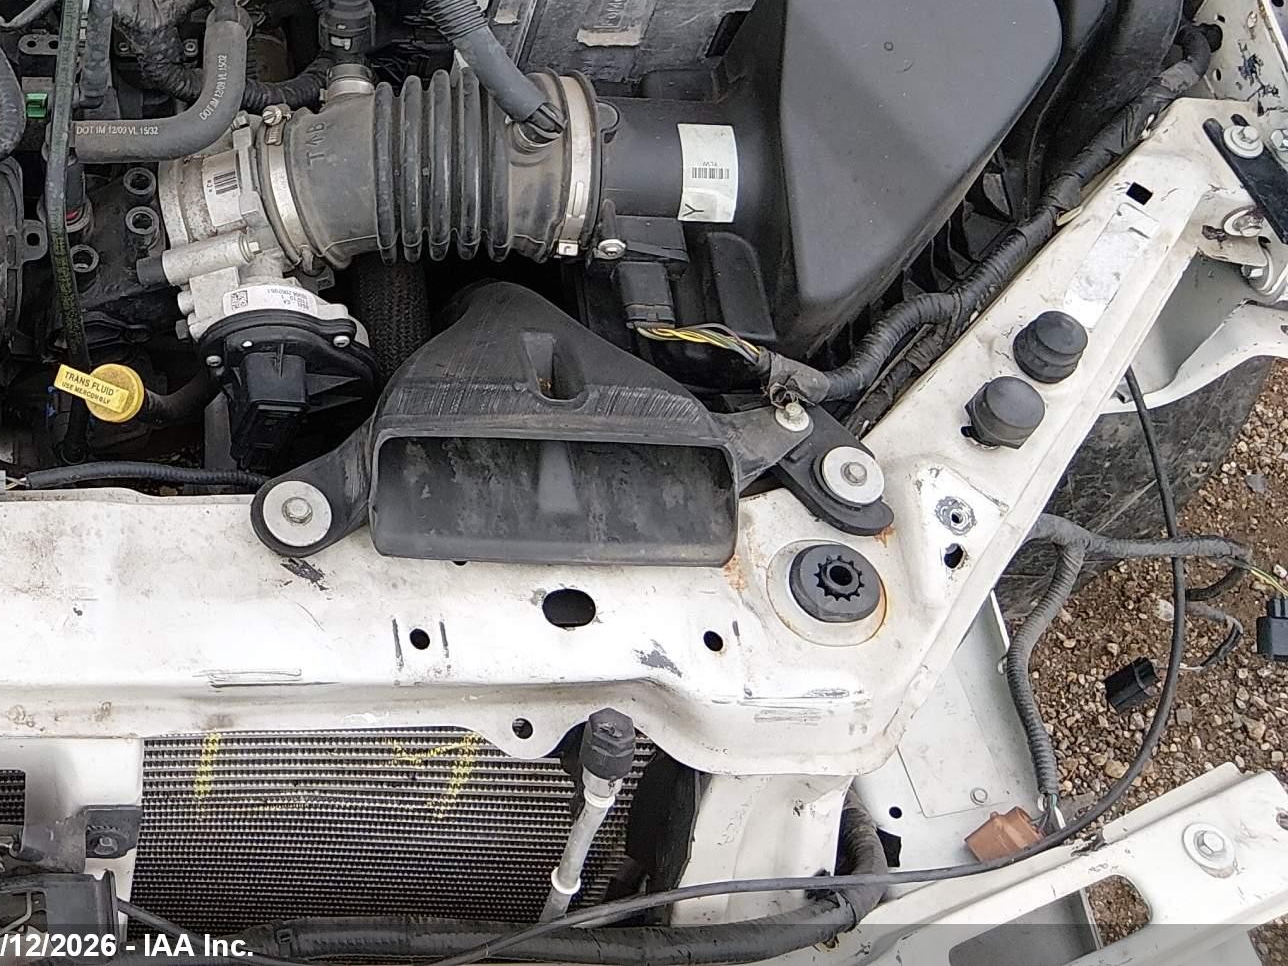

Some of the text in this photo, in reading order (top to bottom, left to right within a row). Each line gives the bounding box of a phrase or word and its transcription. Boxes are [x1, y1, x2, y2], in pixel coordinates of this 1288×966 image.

[76, 125, 94, 135] DOT
[61, 381, 73, 391] USE
[64, 371, 115, 396] TRANS FLUID
